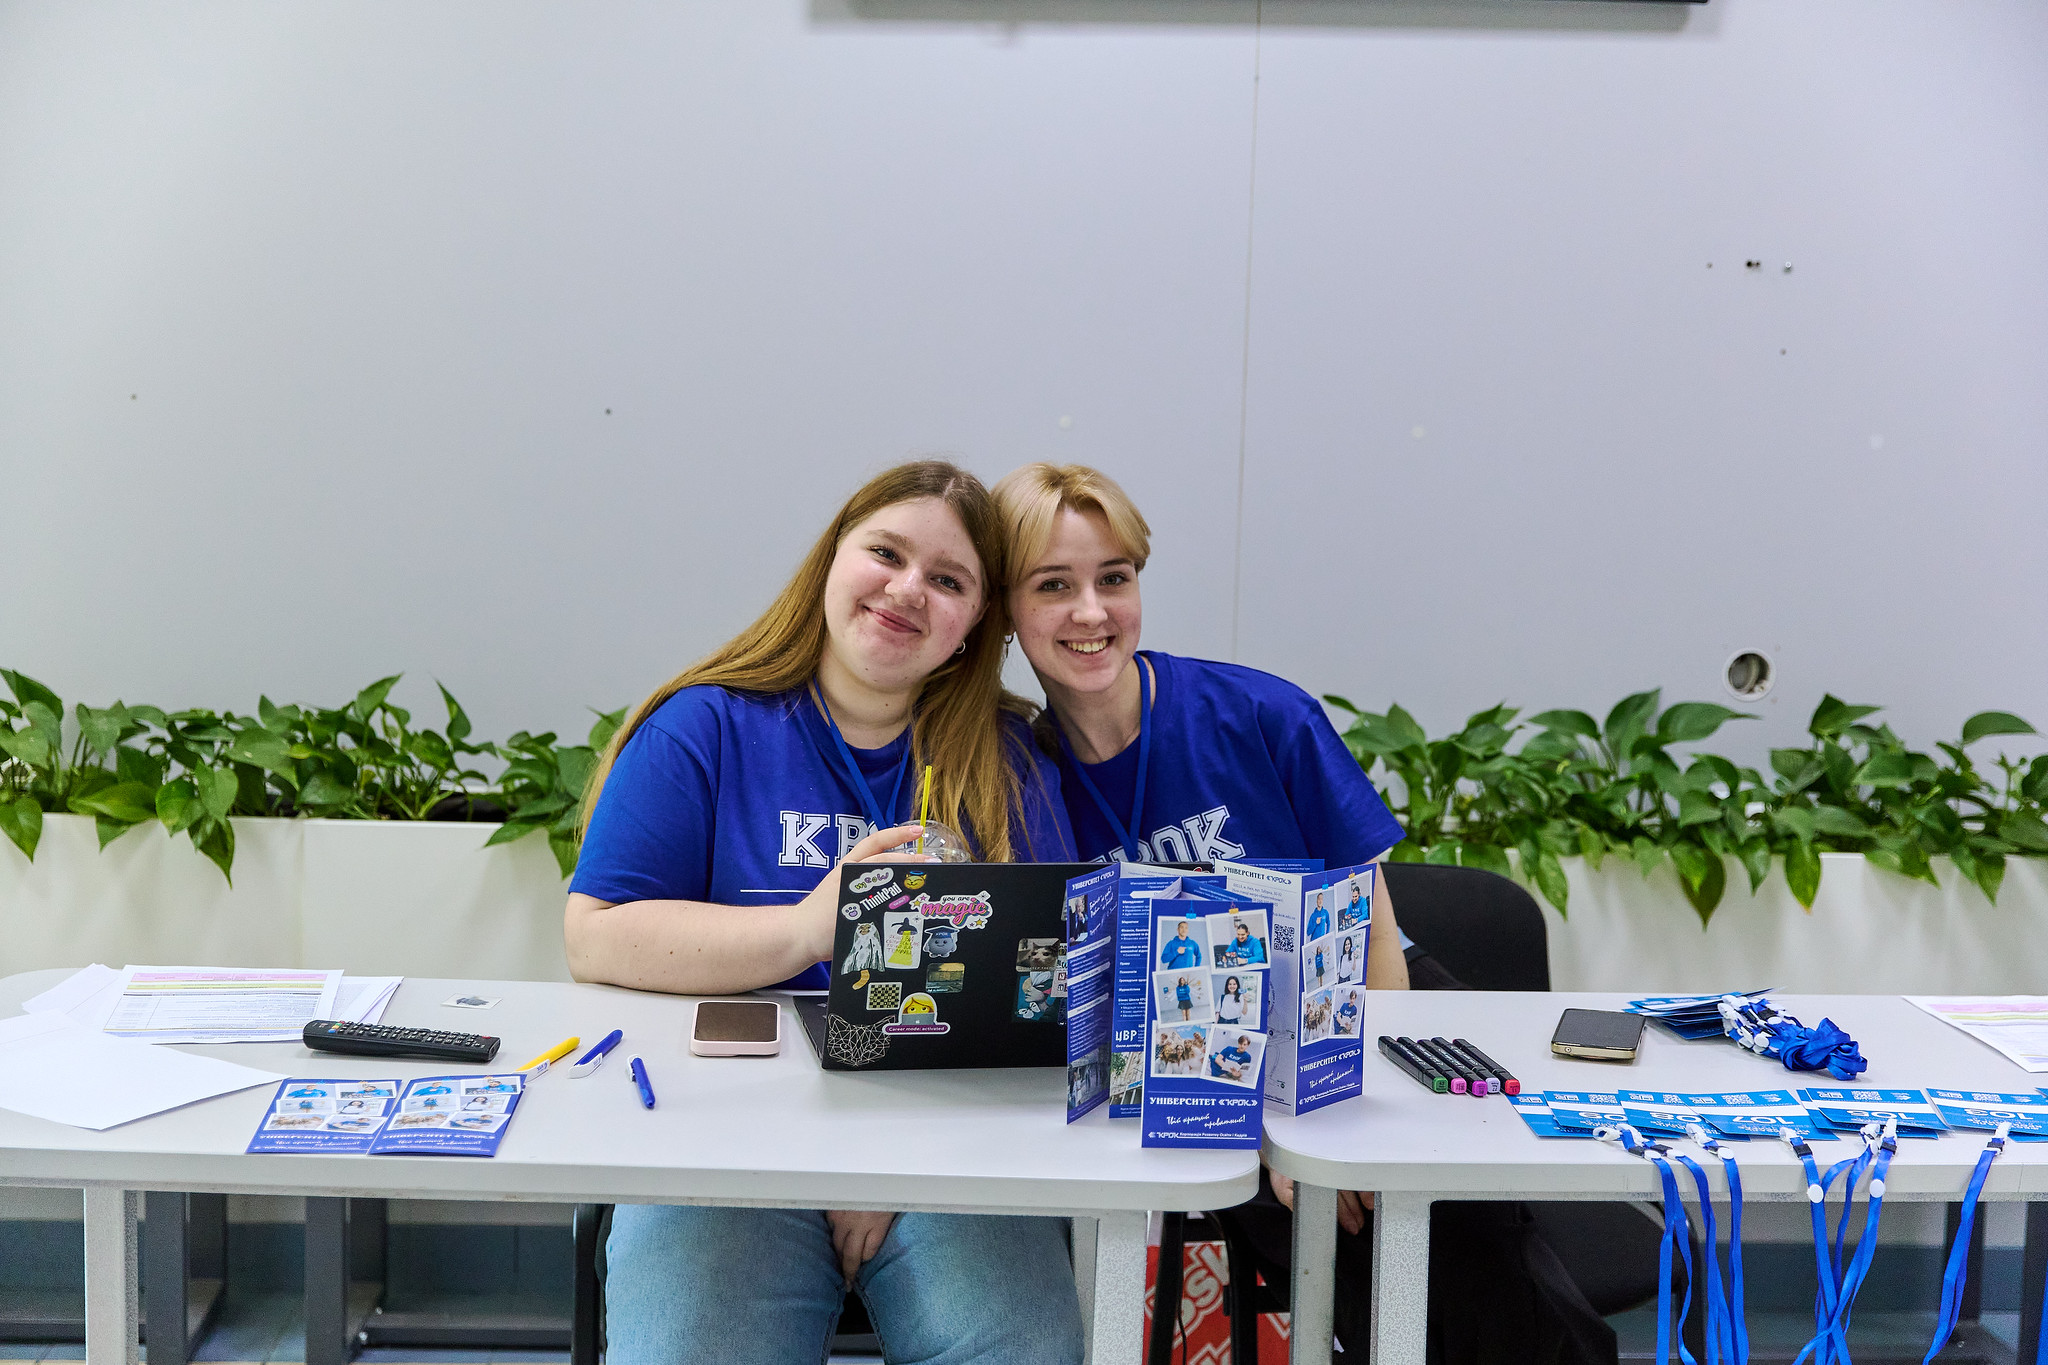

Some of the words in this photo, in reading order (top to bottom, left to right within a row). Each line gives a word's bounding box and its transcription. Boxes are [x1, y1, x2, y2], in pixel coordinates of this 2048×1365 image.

[778, 810, 928, 869] КР
[1090, 805, 1246, 864] ОК
[860, 881, 903, 911] ThinkPad
[921, 898, 988, 926] magic
[1300, 1055, 1338, 1073] УНІВЕРСИТЕТ
[1149, 1097, 1216, 1106] УНІВЕРСИТЕТ
[1578, 1111, 1629, 1122] 09
[1651, 1111, 1702, 1123] 08
[1732, 1115, 1794, 1125] 107
